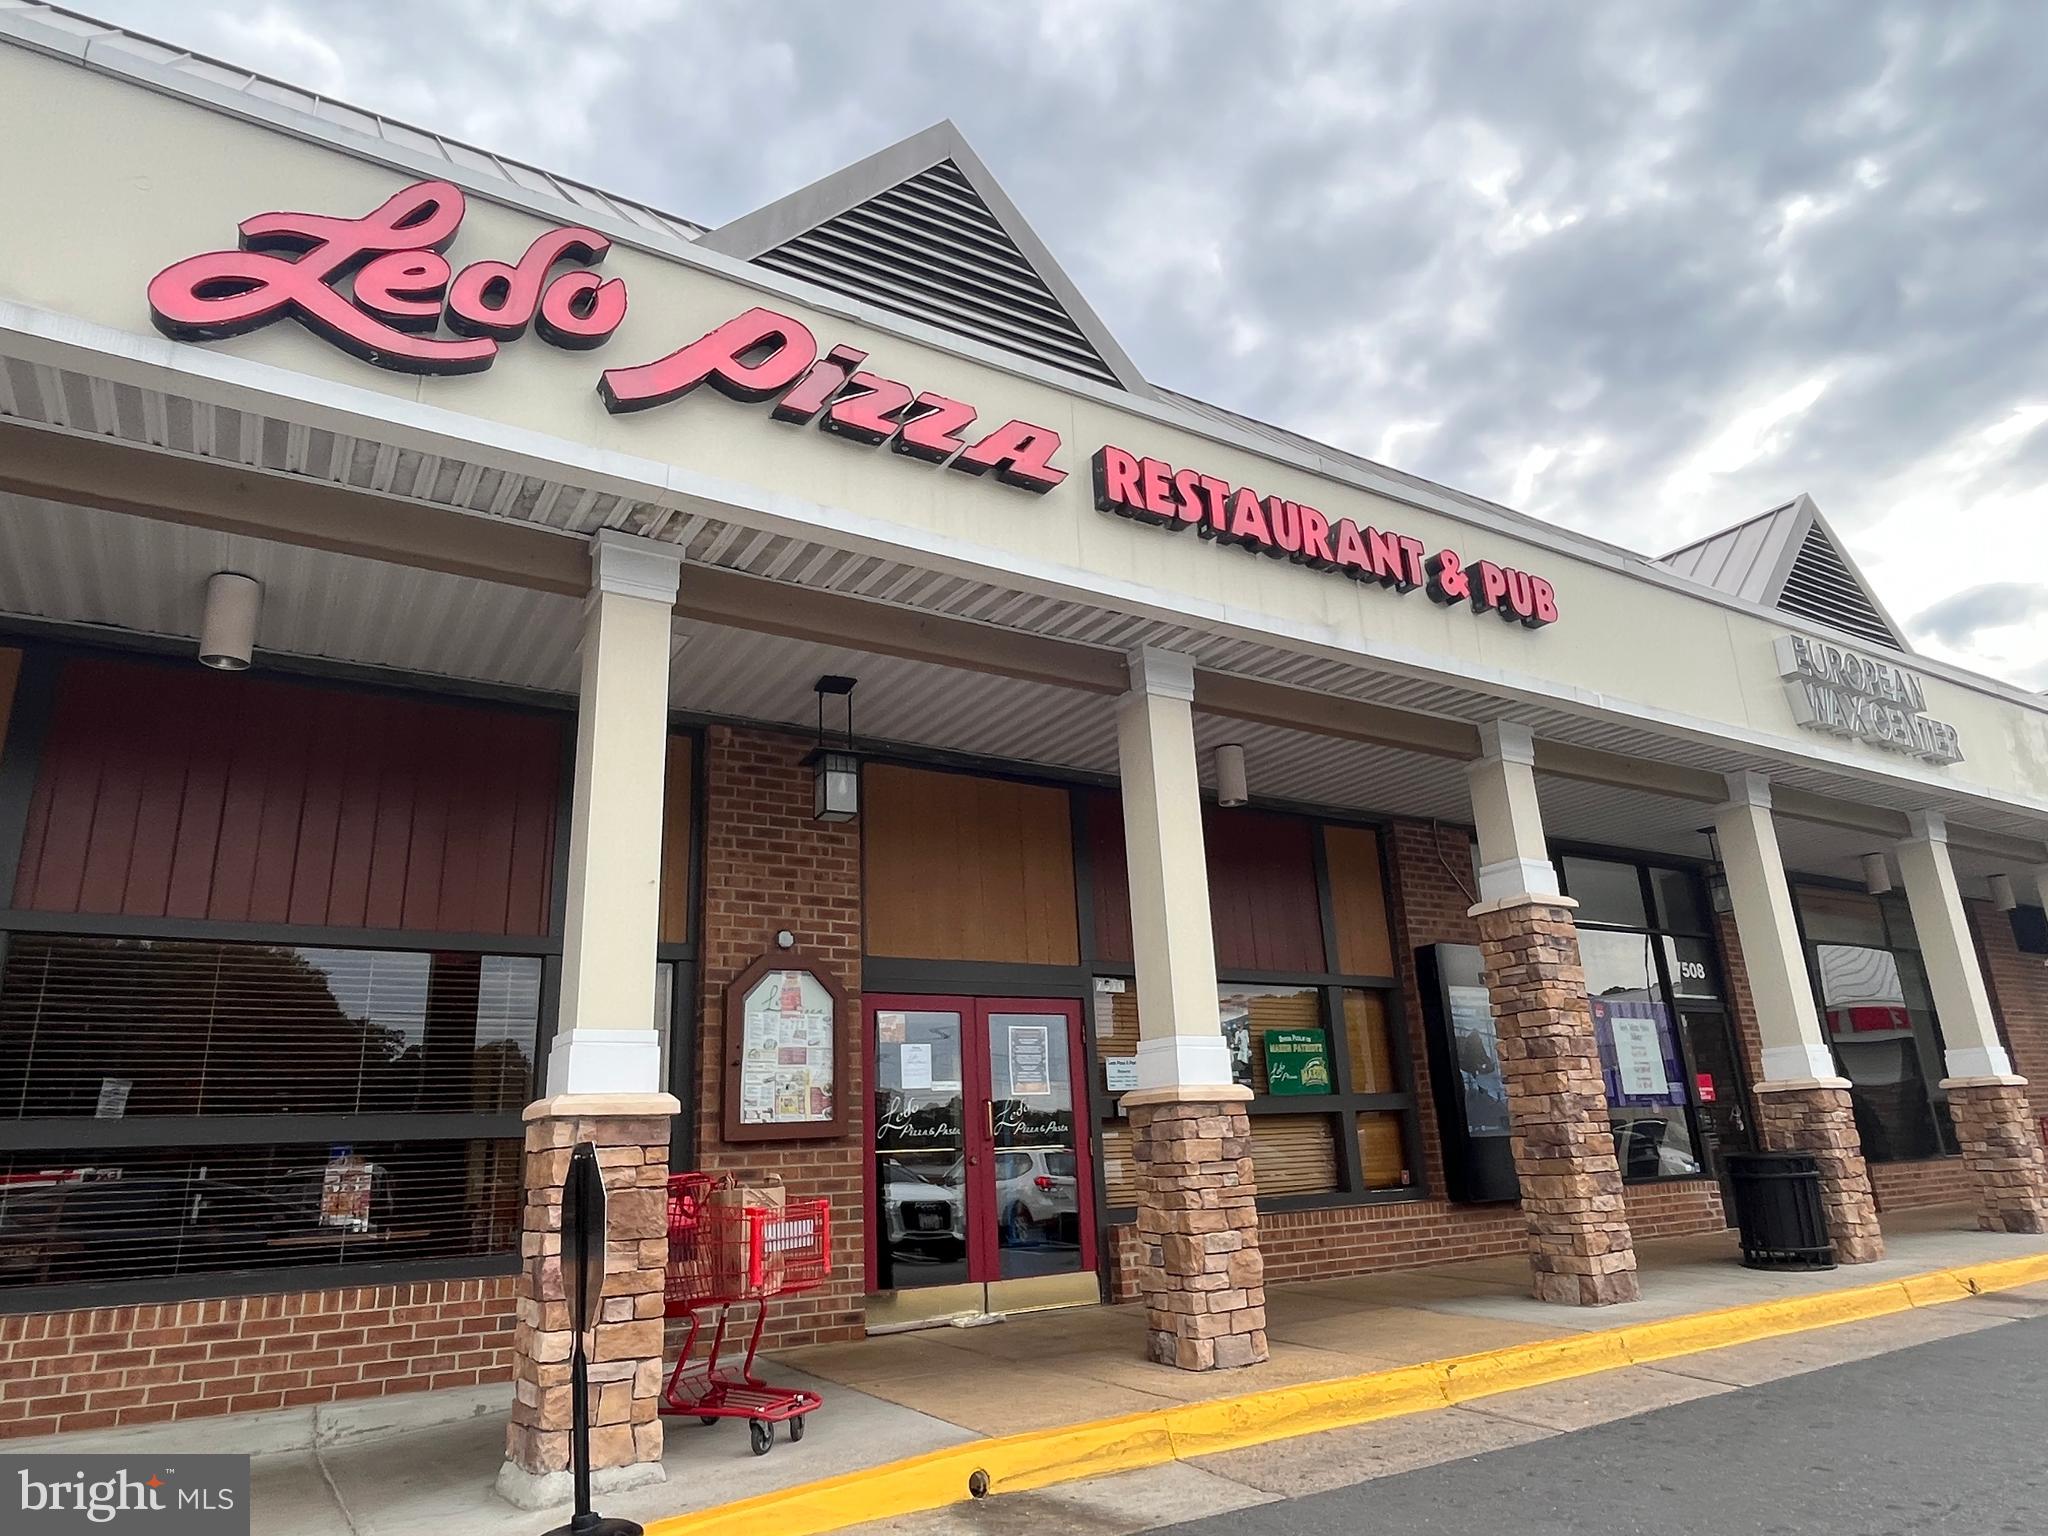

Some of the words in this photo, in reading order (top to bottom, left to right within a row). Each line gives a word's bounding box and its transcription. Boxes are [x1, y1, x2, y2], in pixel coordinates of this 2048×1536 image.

[147, 180, 628, 377] Ledo
[596, 306, 1070, 495] Pizza
[1092, 444, 1425, 595] RESTAURANT
[1426, 549, 1471, 606] &
[1468, 559, 1559, 629] PUB
[1778, 635, 1928, 713] EUROPEAN
[1787, 680, 1869, 739] WAX
[1863, 702, 1966, 764] CENTER
[877, 1096, 920, 1140] Ledo
[994, 1096, 1030, 1136] Ledo
